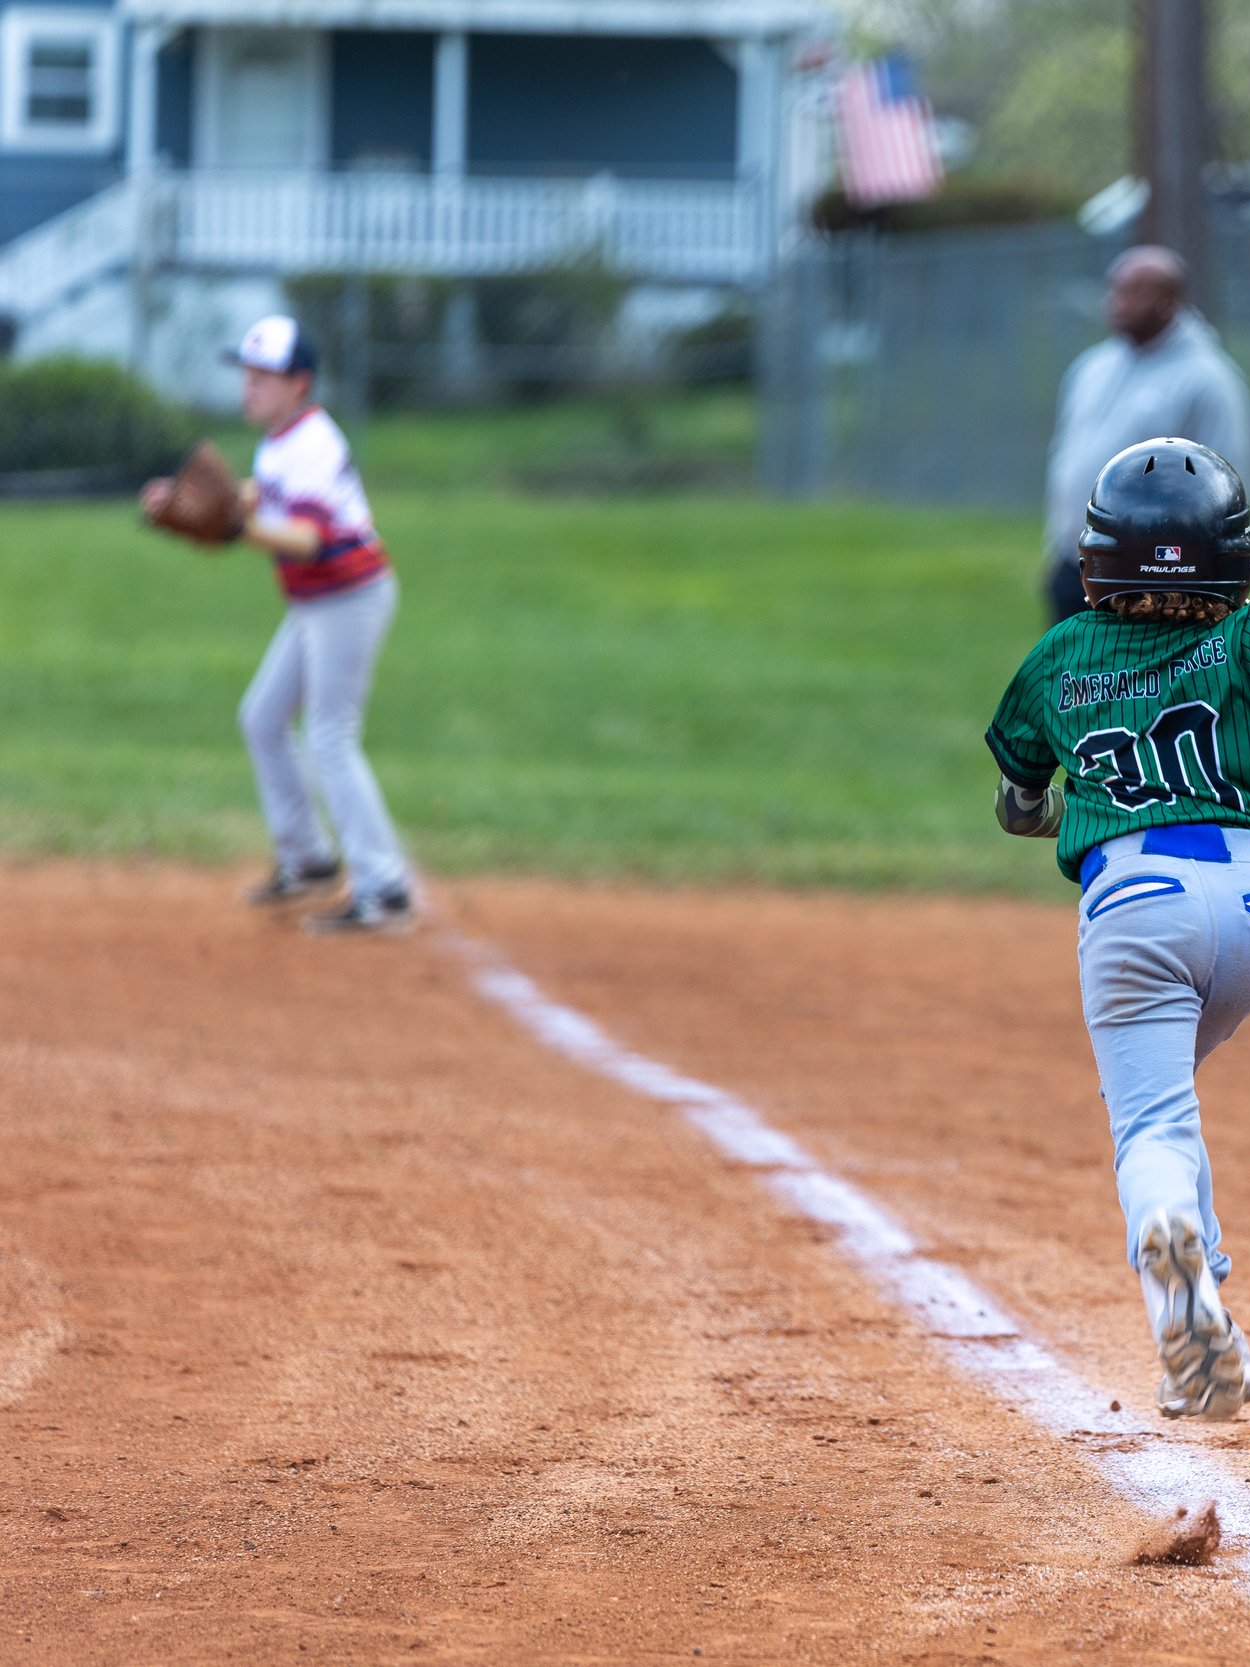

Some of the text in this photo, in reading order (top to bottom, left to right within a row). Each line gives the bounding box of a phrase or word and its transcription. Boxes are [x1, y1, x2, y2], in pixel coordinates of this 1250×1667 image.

[1140, 565, 1196, 573] RAWLINGS
[1058, 635, 1227, 713] EMERALD FRCE
